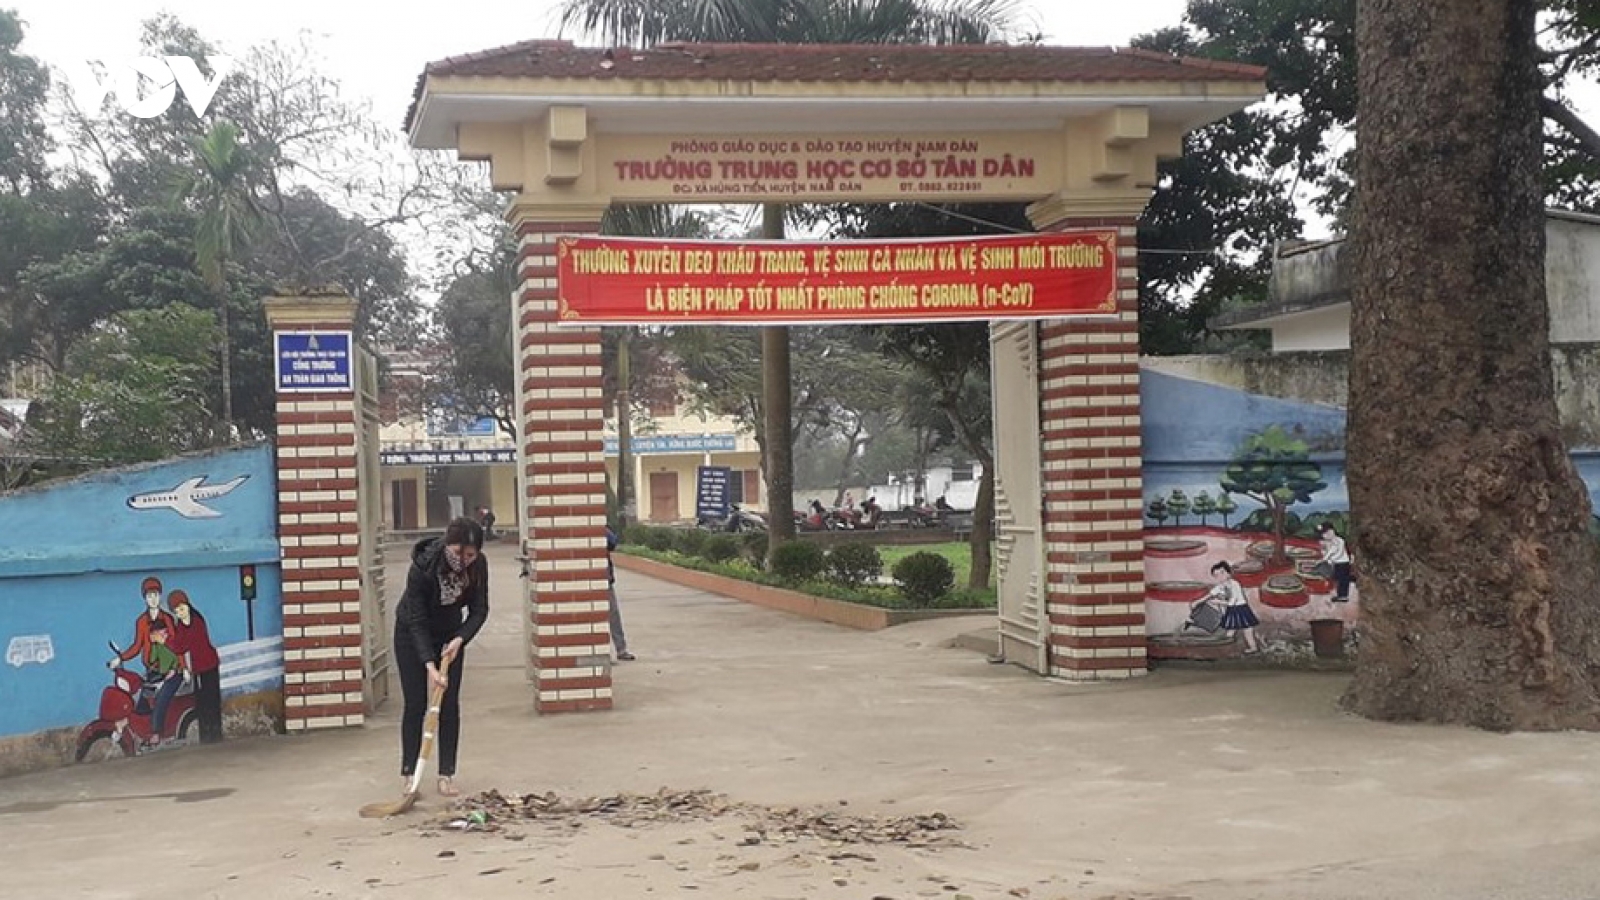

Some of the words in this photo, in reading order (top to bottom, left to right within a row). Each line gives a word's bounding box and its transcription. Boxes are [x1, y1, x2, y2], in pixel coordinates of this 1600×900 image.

[672, 139, 718, 153] PHÒNG
[721, 138, 755, 153] GIÁO
[759, 141, 787, 156] DỤC
[790, 141, 801, 153] &
[837, 140, 864, 155] TẠO
[867, 138, 912, 155] HUYỆN
[916, 140, 947, 153] NAM
[614, 155, 712, 180] TRƯỜNG
[717, 160, 798, 180] TRUNG
[806, 160, 854, 184] HỌC
[860, 158, 892, 179] CƠ
[896, 151, 927, 179] SỞ
[931, 155, 977, 178] TÂN
[982, 153, 1035, 177] DÂN
[571, 243, 630, 274] THƯỜNG
[633, 245, 681, 274] XUYÊN
[759, 250, 810, 276] TRANG,
[813, 245, 831, 278] VỆ
[835, 249, 869, 273] SINH
[896, 244, 936, 272] NHÂN
[938, 243, 956, 271] VÀ
[960, 242, 977, 276] VỆ
[981, 247, 1015, 270] SINH
[1018, 241, 1045, 269] MÔI
[1049, 239, 1104, 269] TRƯỜNG
[646, 282, 664, 311] LÀ
[668, 282, 702, 316] BIỆN
[706, 282, 744, 311] PHÁP
[747, 279, 773, 310] TỐT
[776, 278, 815, 310] NHẤT
[817, 280, 867, 310] PHÒNG
[870, 277, 918, 309] CHỐNG
[921, 284, 979, 308] CORONA
[982, 282, 1034, 308] (n-CoV)
